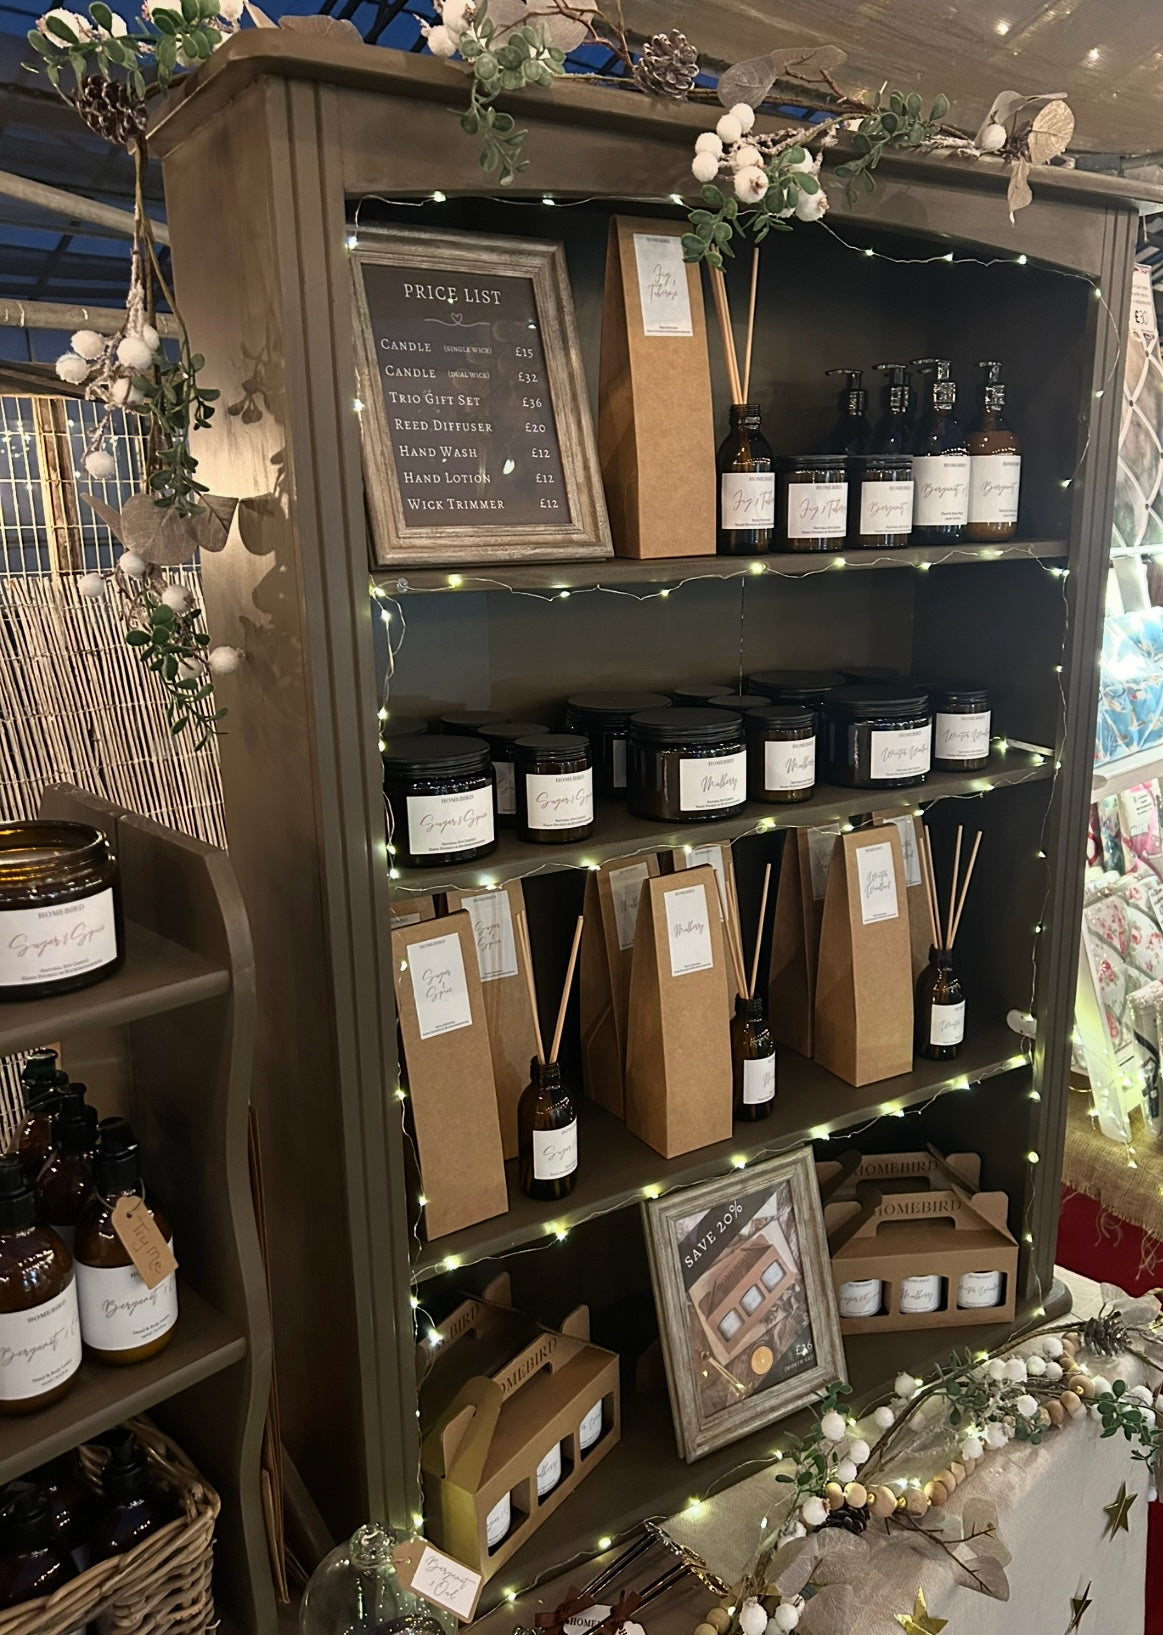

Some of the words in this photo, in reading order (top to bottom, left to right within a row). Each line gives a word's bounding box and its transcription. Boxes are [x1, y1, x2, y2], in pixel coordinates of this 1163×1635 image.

[403, 283, 458, 301] PRICE
[464, 288, 501, 305] LIST
[380, 338, 432, 352] CANDLE
[515, 347, 534, 358] £15
[385, 366, 437, 379] CANDLE
[518, 373, 538, 383] £32
[389, 392, 421, 404] TRIO
[425, 393, 454, 405] GIFT
[458, 395, 481, 406] SET
[522, 398, 542, 408] £36
[394, 419, 429, 431] REED
[433, 420, 493, 432] DIFFUSER
[525, 423, 546, 433] £20
[399, 446, 437, 457] HAND
[440, 446, 478, 458] WASH
[532, 448, 550, 458] £12
[404, 472, 441, 483] HAND
[445, 472, 491, 484] LOTION
[536, 474, 555, 484] £12
[407, 498, 444, 510] WICK
[446, 498, 505, 510] TRIMMER
[540, 499, 559, 509] £12
[38, 903, 85, 919] HOMEBIRD
[854, 1160, 939, 1177] HOMEBIRD
[873, 1199, 962, 1217] HOMEBIRD
[133, 1215, 150, 1252] Try
[684, 1231, 717, 1268] SAVE
[716, 1200, 743, 1233] 20%
[102, 1283, 165, 1318] Bergamot
[500, 1336, 558, 1394] OMEBIRD
